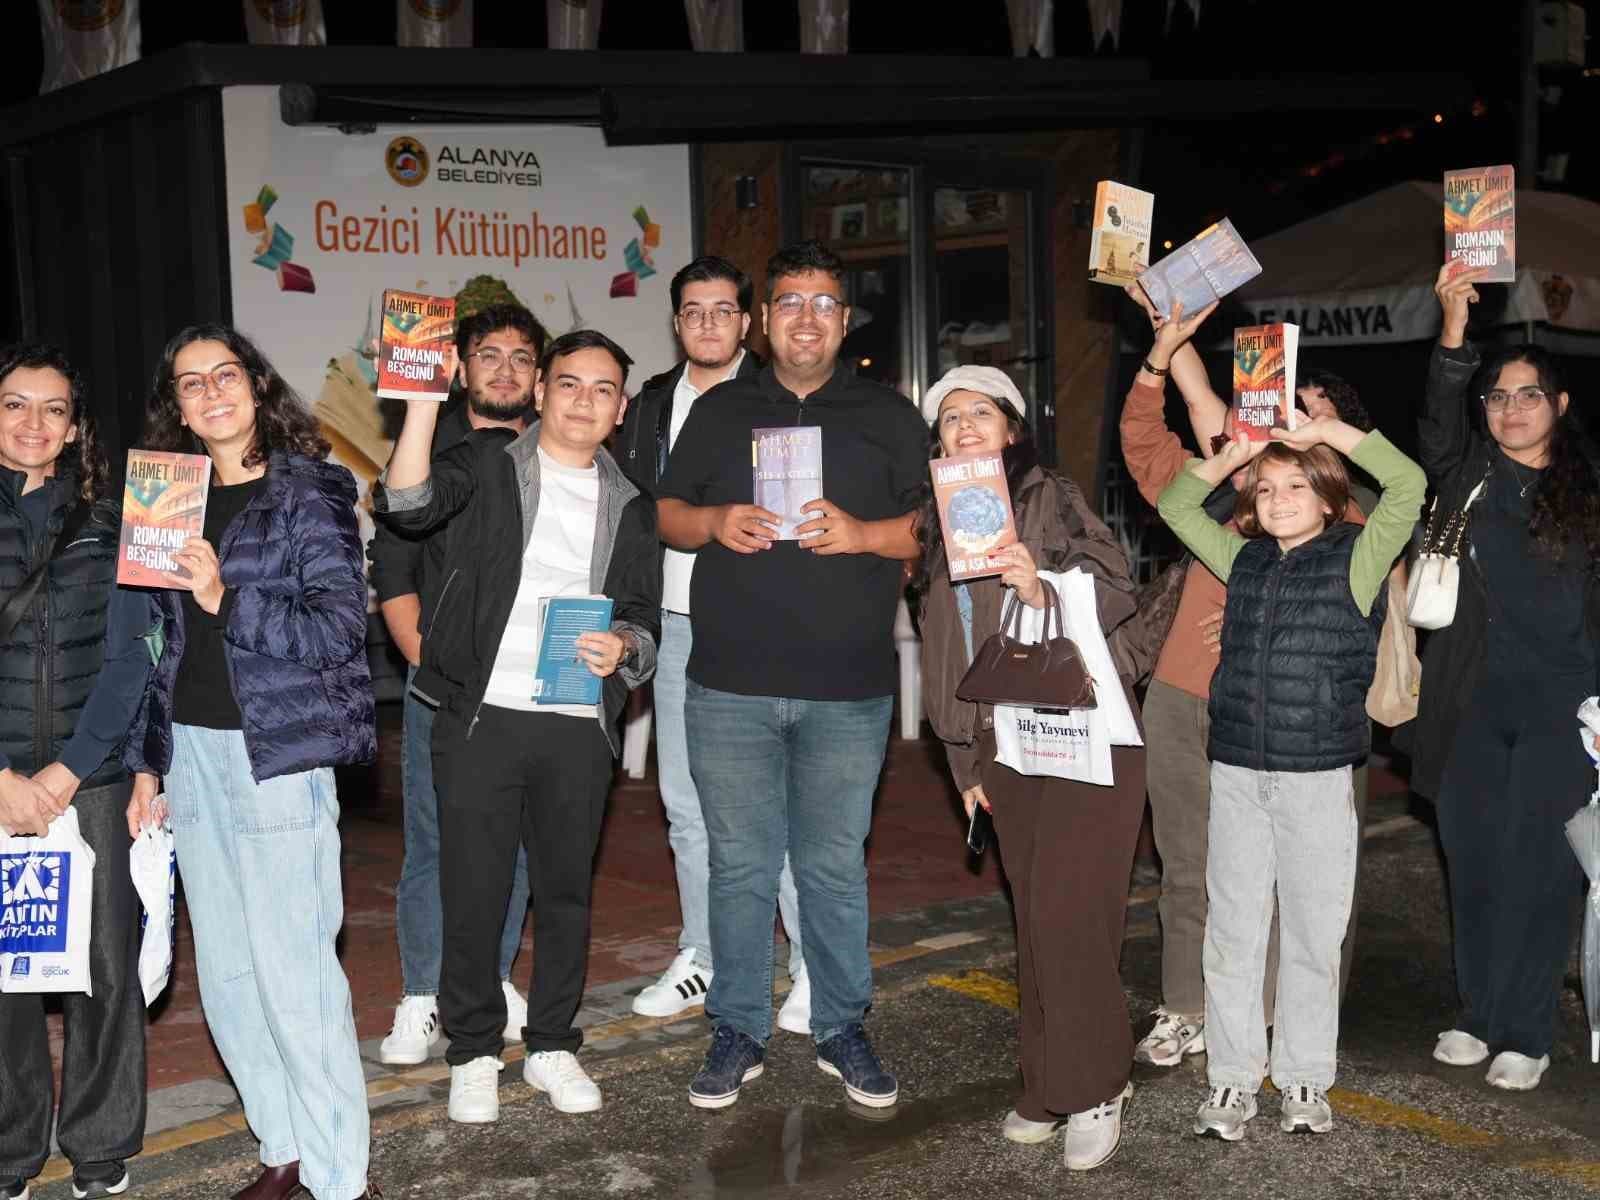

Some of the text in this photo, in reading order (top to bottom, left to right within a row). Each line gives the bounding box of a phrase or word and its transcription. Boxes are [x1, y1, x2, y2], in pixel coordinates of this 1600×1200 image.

[437, 146, 540, 168] ALANYA
[437, 168, 542, 186] BELEDİYESİ
[1447, 178, 1481, 193] AHMET
[315, 200, 607, 267] Gezici Kütüphane
[388, 298, 424, 315] AHMET
[1285, 303, 1393, 337] ALANYA
[1237, 335, 1262, 352] AHMET
[130, 461, 171, 481] AHMET
[937, 462, 973, 485] AHMET
[127, 545, 147, 566] BEŞ
